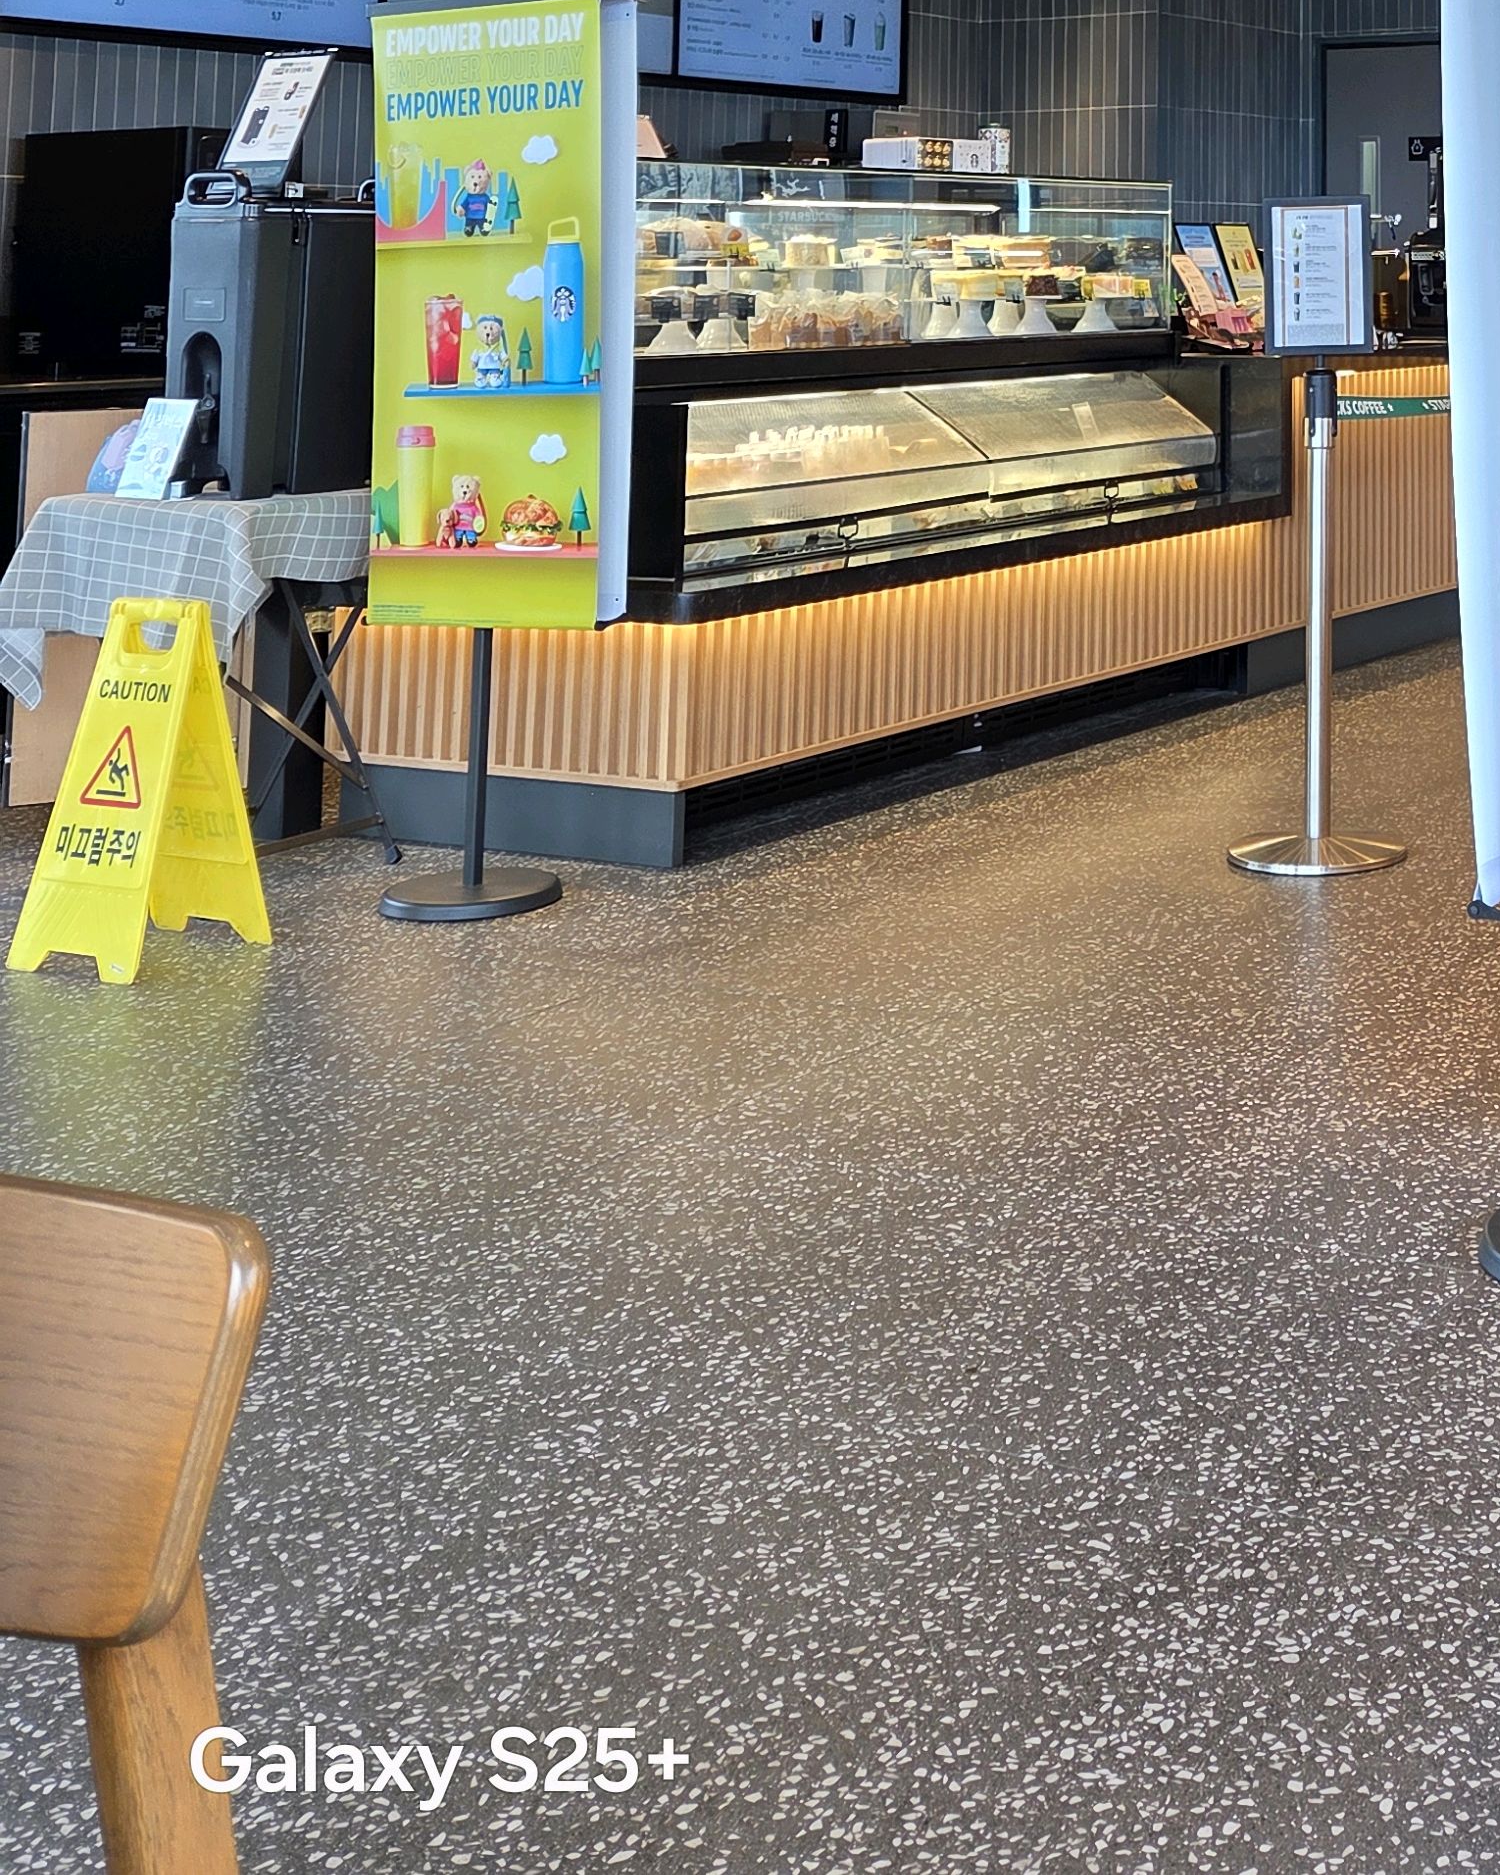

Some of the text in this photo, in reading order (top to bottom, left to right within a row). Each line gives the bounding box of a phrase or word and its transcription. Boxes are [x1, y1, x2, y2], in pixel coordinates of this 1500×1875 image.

[386, 12, 585, 58] EMPOWER YOUR DAY
[386, 45, 585, 90] EMPOWER YOUR DAY
[386, 79, 584, 123] EMPOWER YOUR DAY
[777, 211, 840, 222] STARBUC
[1352, 401, 1387, 415] COFFEE
[99, 679, 172, 703] CAUTION
[55, 823, 142, 869] 미끄럼주의
